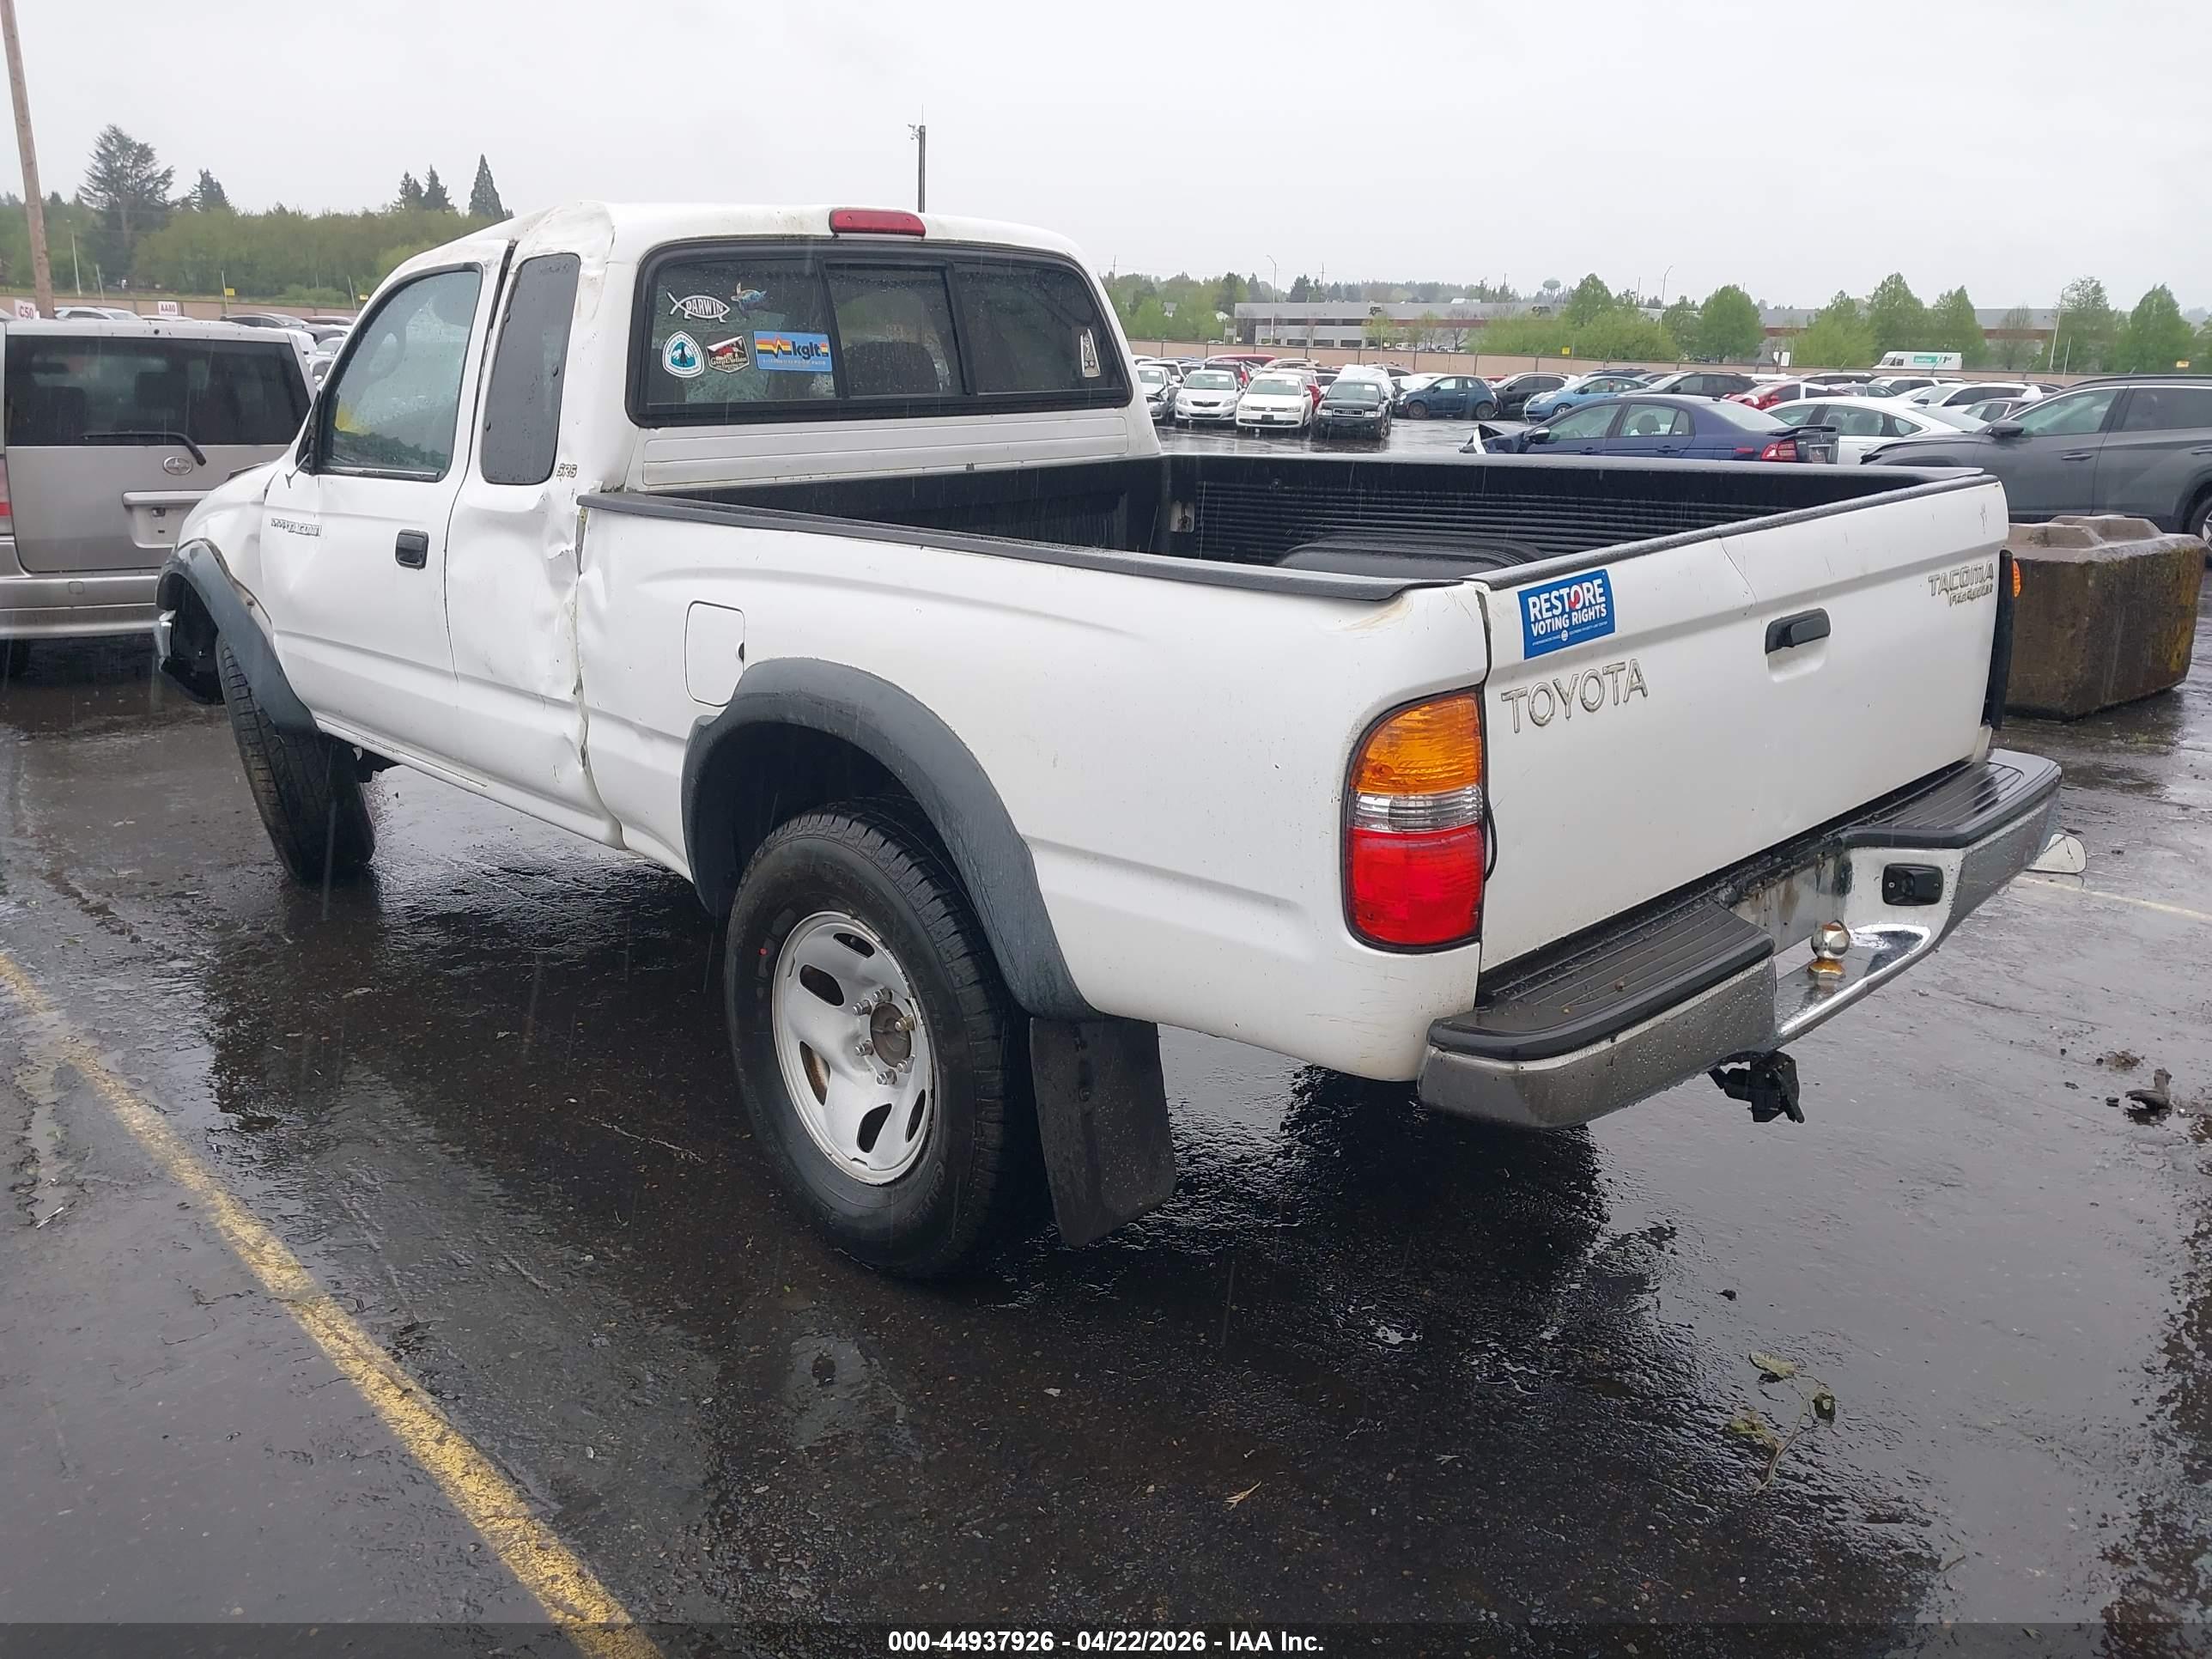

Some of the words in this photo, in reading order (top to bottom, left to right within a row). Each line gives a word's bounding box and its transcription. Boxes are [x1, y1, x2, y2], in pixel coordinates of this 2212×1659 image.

[686, 298, 723, 315] DARWIN
[1928, 561, 1994, 596] TACOMA
[1528, 579, 1606, 622] RESTORE
[1530, 614, 1570, 637] VOTING
[1571, 603, 1607, 626] RIGHTS
[1501, 659, 1648, 733] TOYOTA
